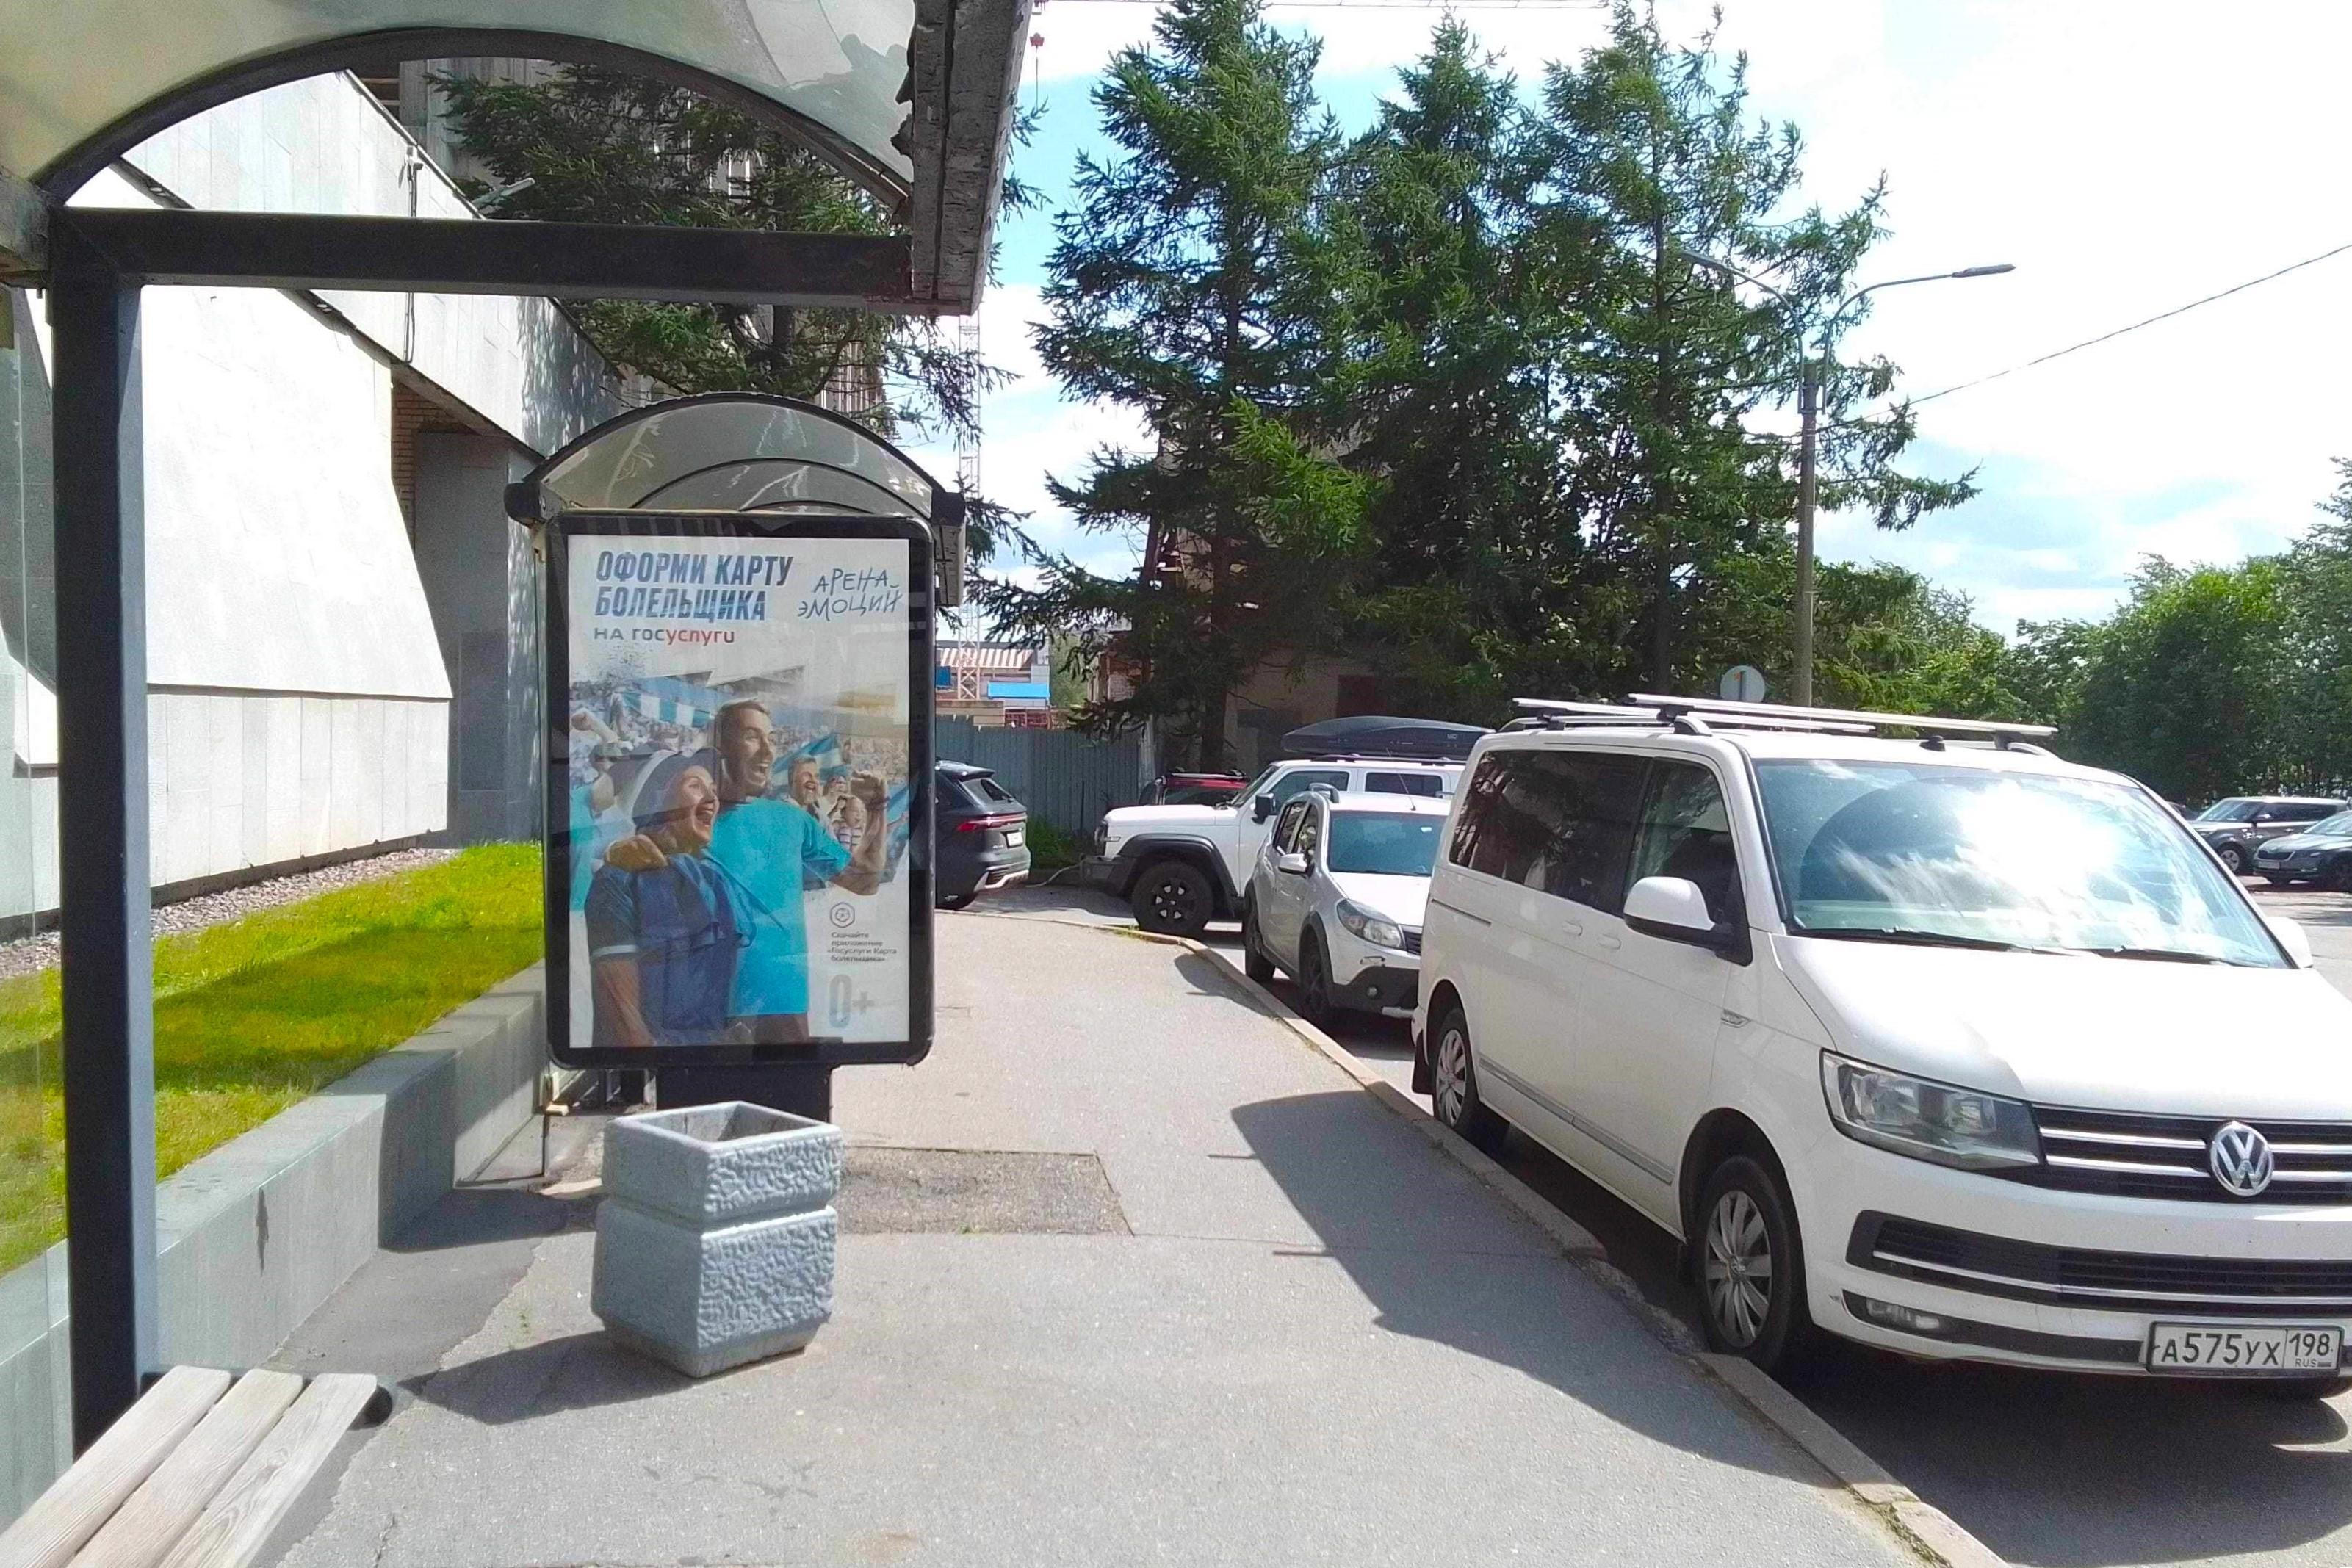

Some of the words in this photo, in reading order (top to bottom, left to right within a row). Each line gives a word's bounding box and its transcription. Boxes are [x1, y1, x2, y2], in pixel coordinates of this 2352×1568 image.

[595, 550, 708, 585] ОФОРМИ
[714, 554, 794, 586] КАРТУ
[813, 568, 888, 596] АРЕНА
[594, 586, 767, 623] БОЛЕЛЬЩИКА
[797, 585, 903, 622] ЭМОЦИЙ
[594, 627, 624, 640] НА
[829, 974, 876, 1029] 0+
[2288, 1332, 2331, 1357] 198
[2295, 1359, 2317, 1368] RUS
